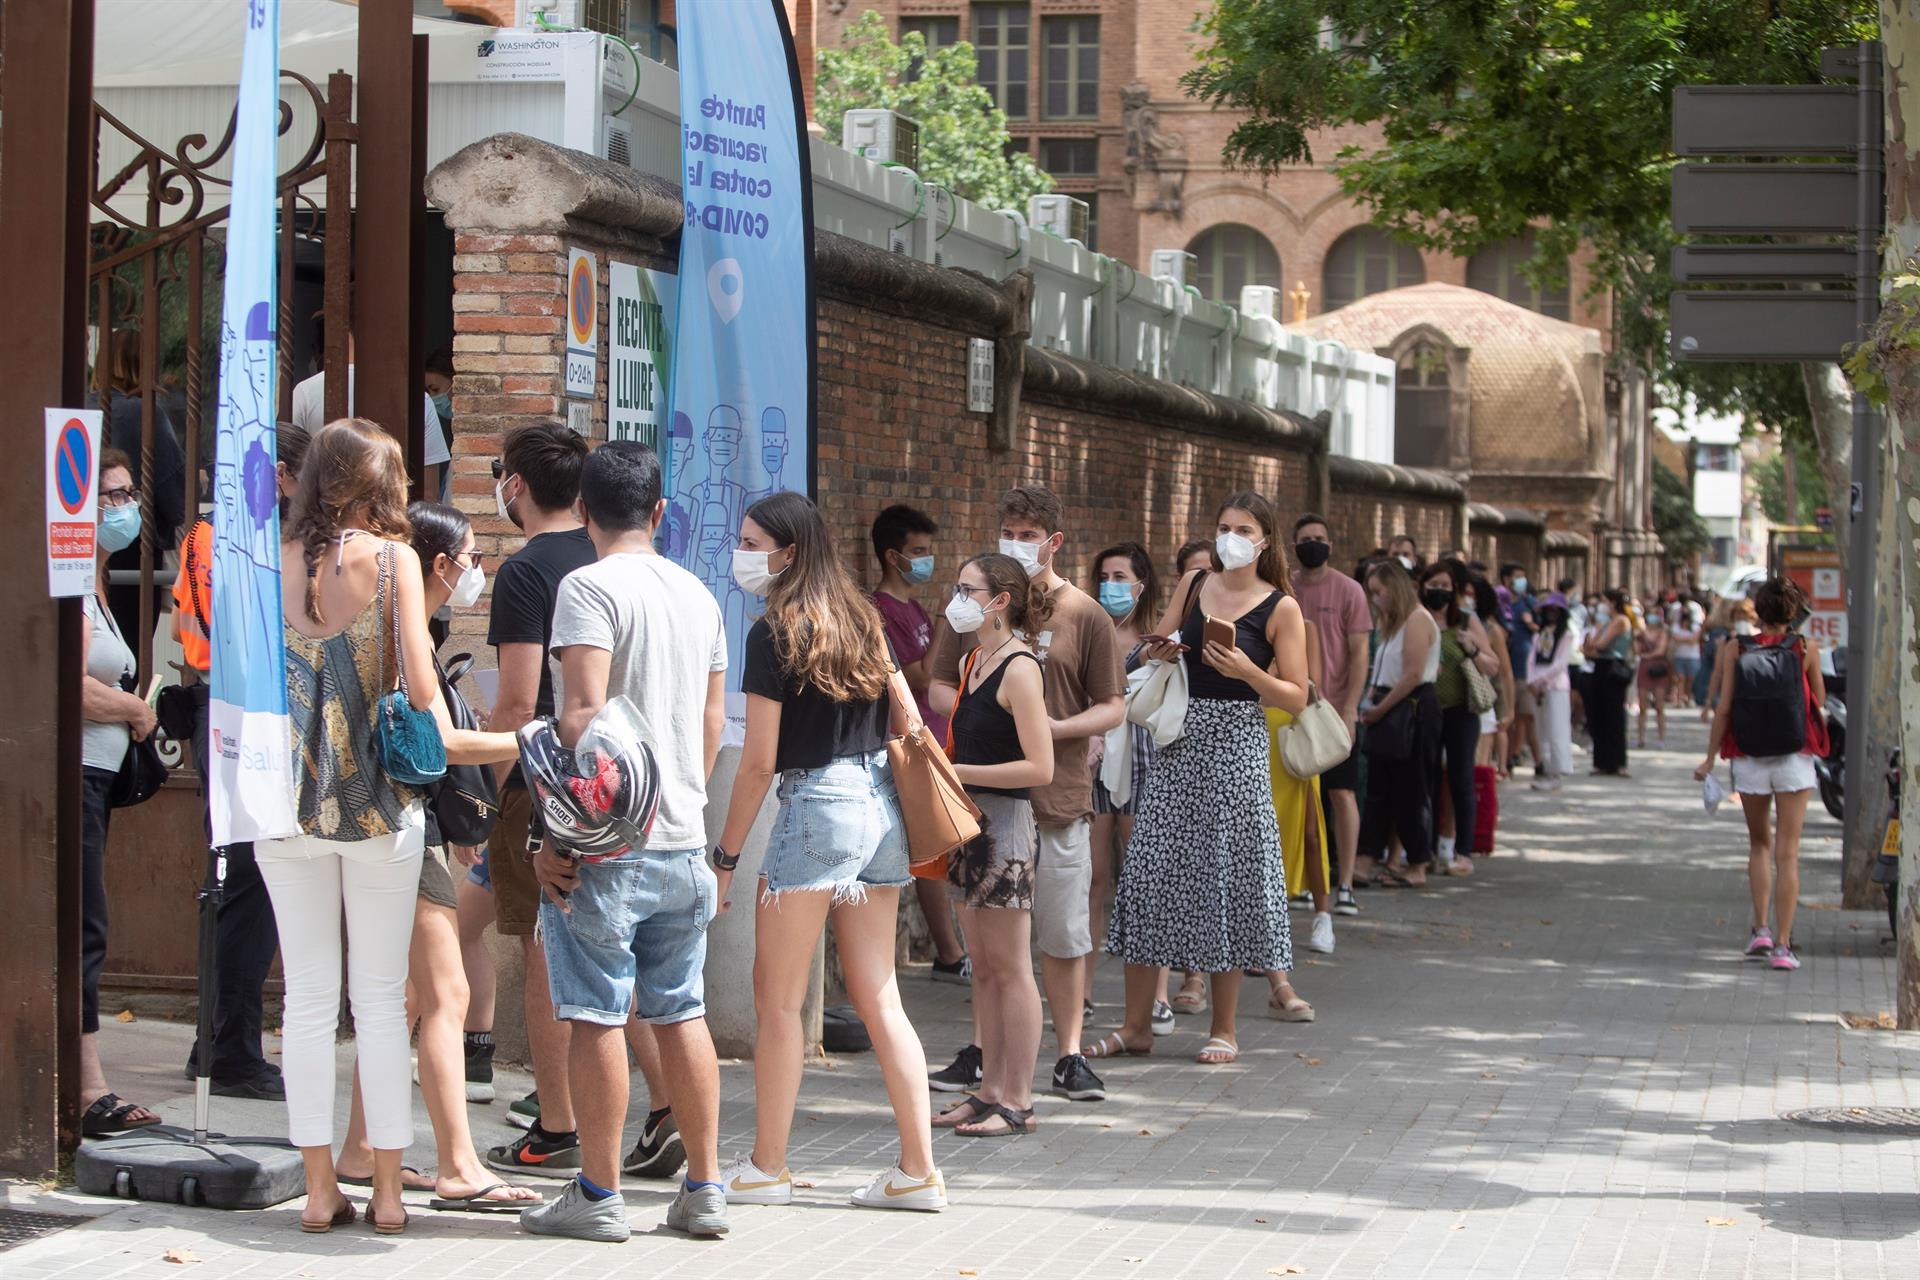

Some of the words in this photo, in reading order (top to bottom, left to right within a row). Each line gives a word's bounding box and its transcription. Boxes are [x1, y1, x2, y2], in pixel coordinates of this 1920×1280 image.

[498, 41, 560, 50] WASHINGTON
[617, 296, 663, 352] RECINTE
[616, 358, 654, 411] LLIURE
[242, 743, 283, 771] Salu
[549, 799, 573, 825] SHOEI
